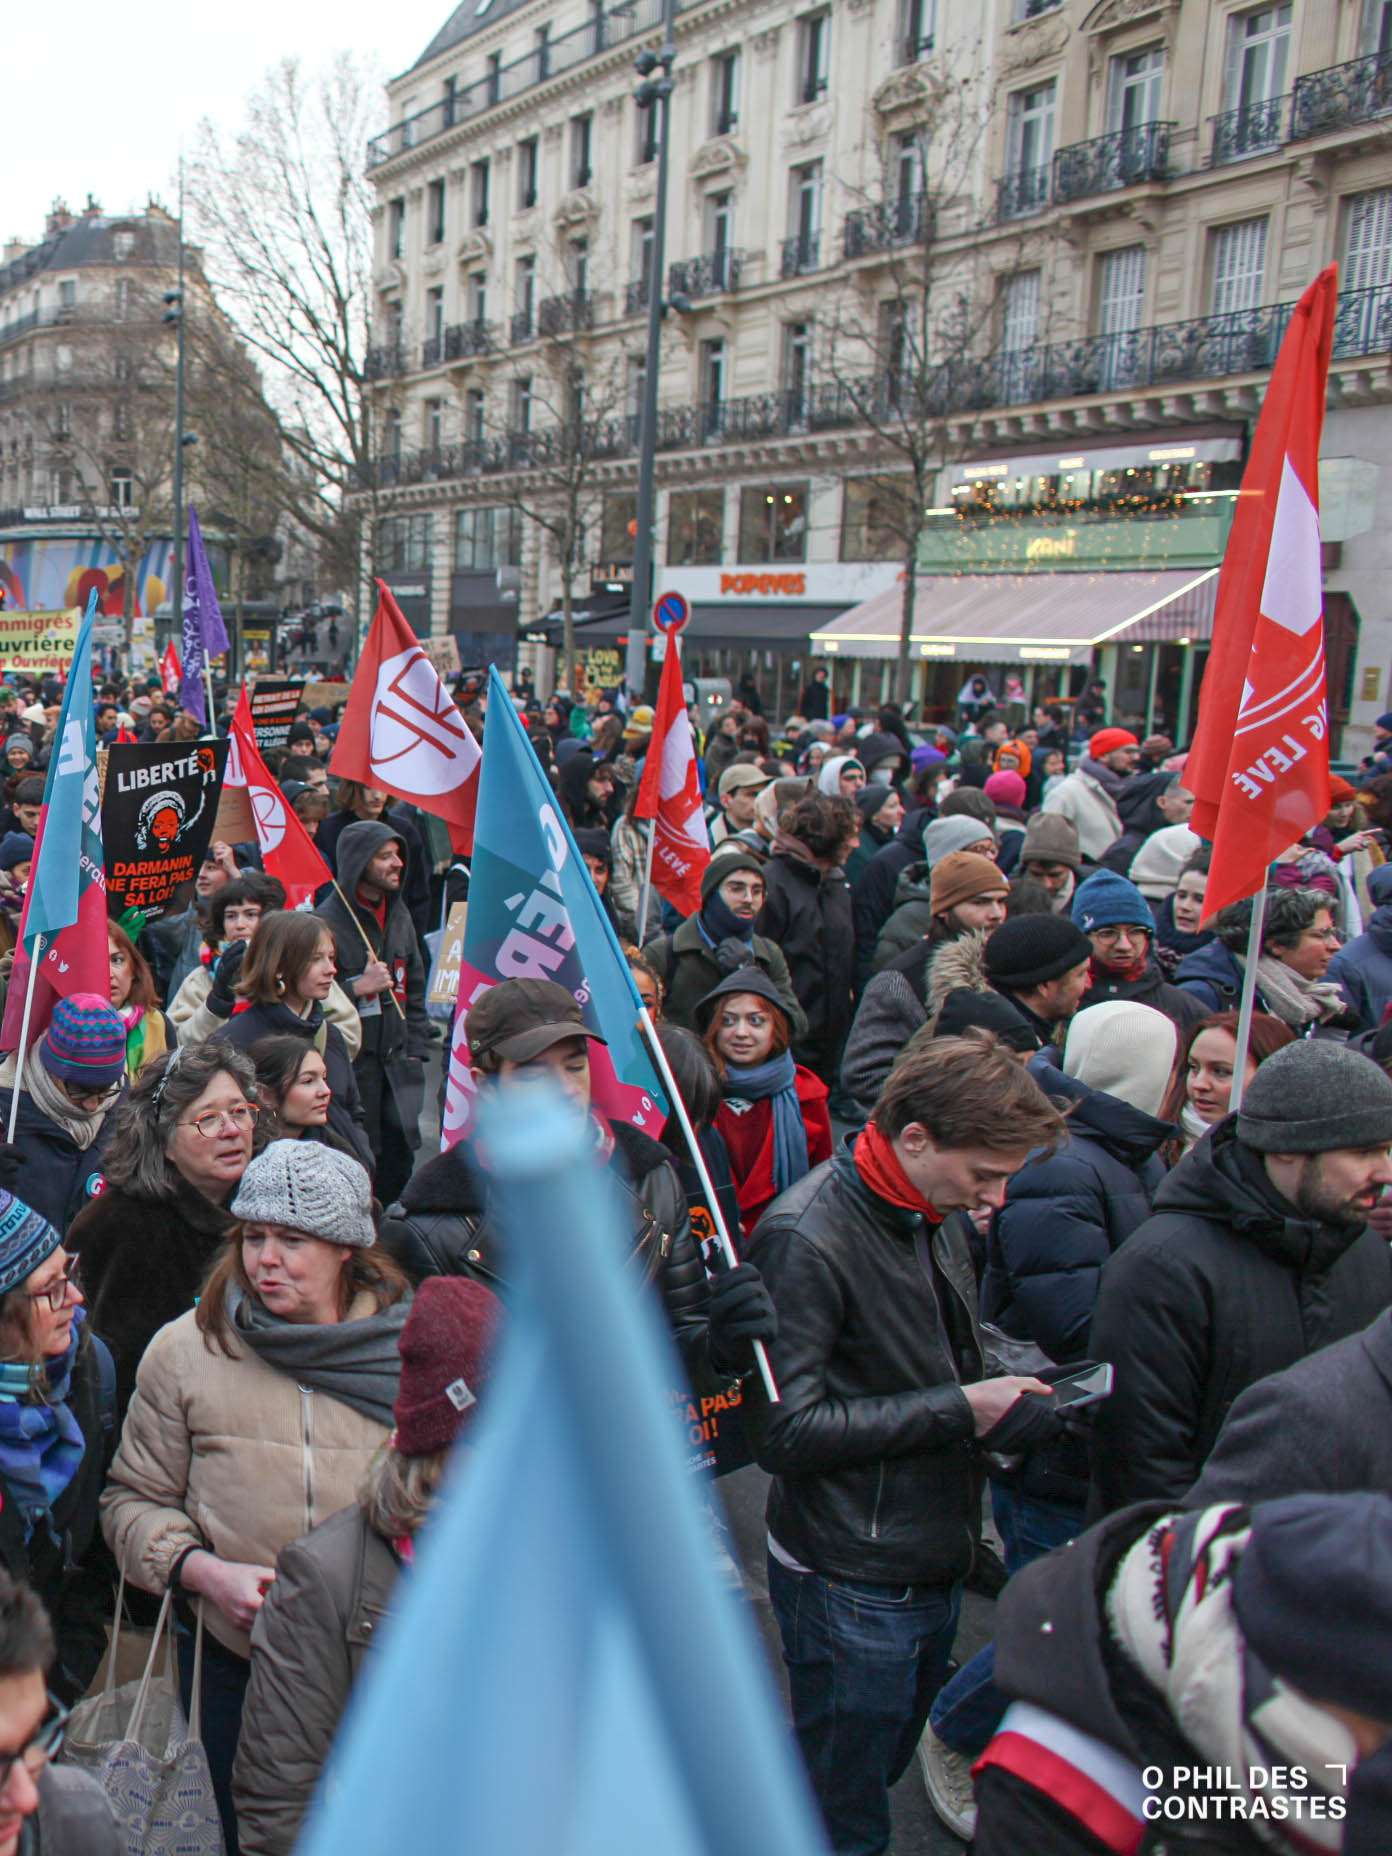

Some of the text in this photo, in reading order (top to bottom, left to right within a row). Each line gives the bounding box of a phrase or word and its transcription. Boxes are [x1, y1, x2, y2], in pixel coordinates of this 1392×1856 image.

[117, 749, 200, 793] LIBERTÉ
[113, 856, 193, 877] DARMANIN
[105, 867, 195, 892] NE FERA PAS
[123, 890, 146, 907] SA
[689, 1417, 719, 1446] OI!
